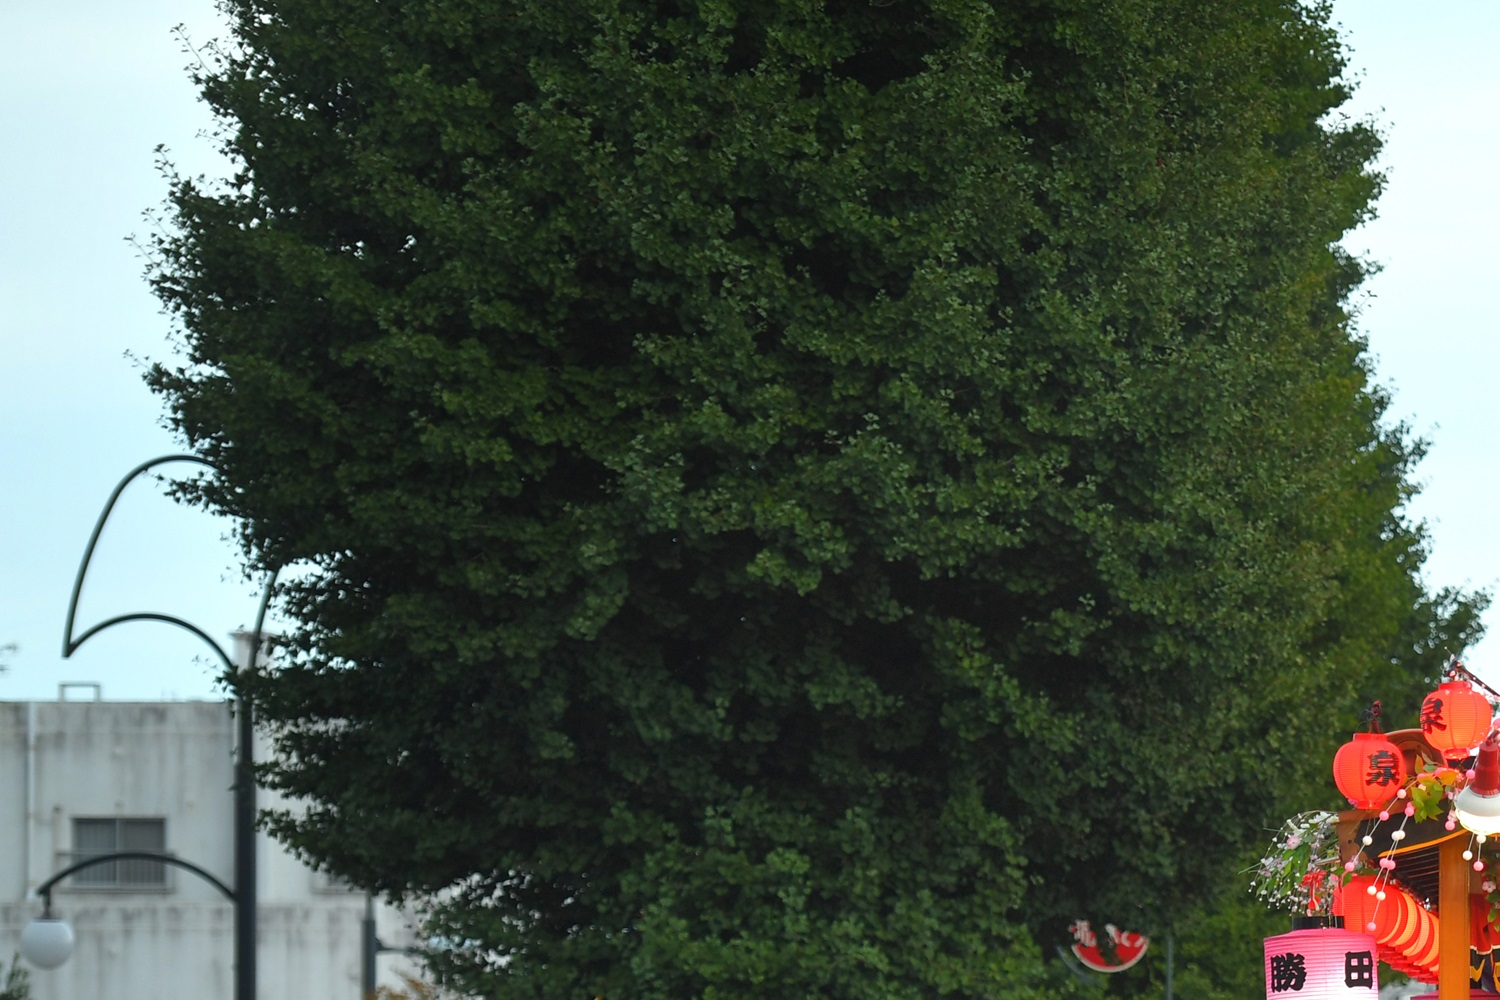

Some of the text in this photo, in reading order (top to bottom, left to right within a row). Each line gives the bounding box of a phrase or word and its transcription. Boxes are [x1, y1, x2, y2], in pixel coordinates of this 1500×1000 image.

[1420, 698, 1446, 734] 泉
[1365, 750, 1400, 786] 泉
[1271, 951, 1373, 993] 勝田
